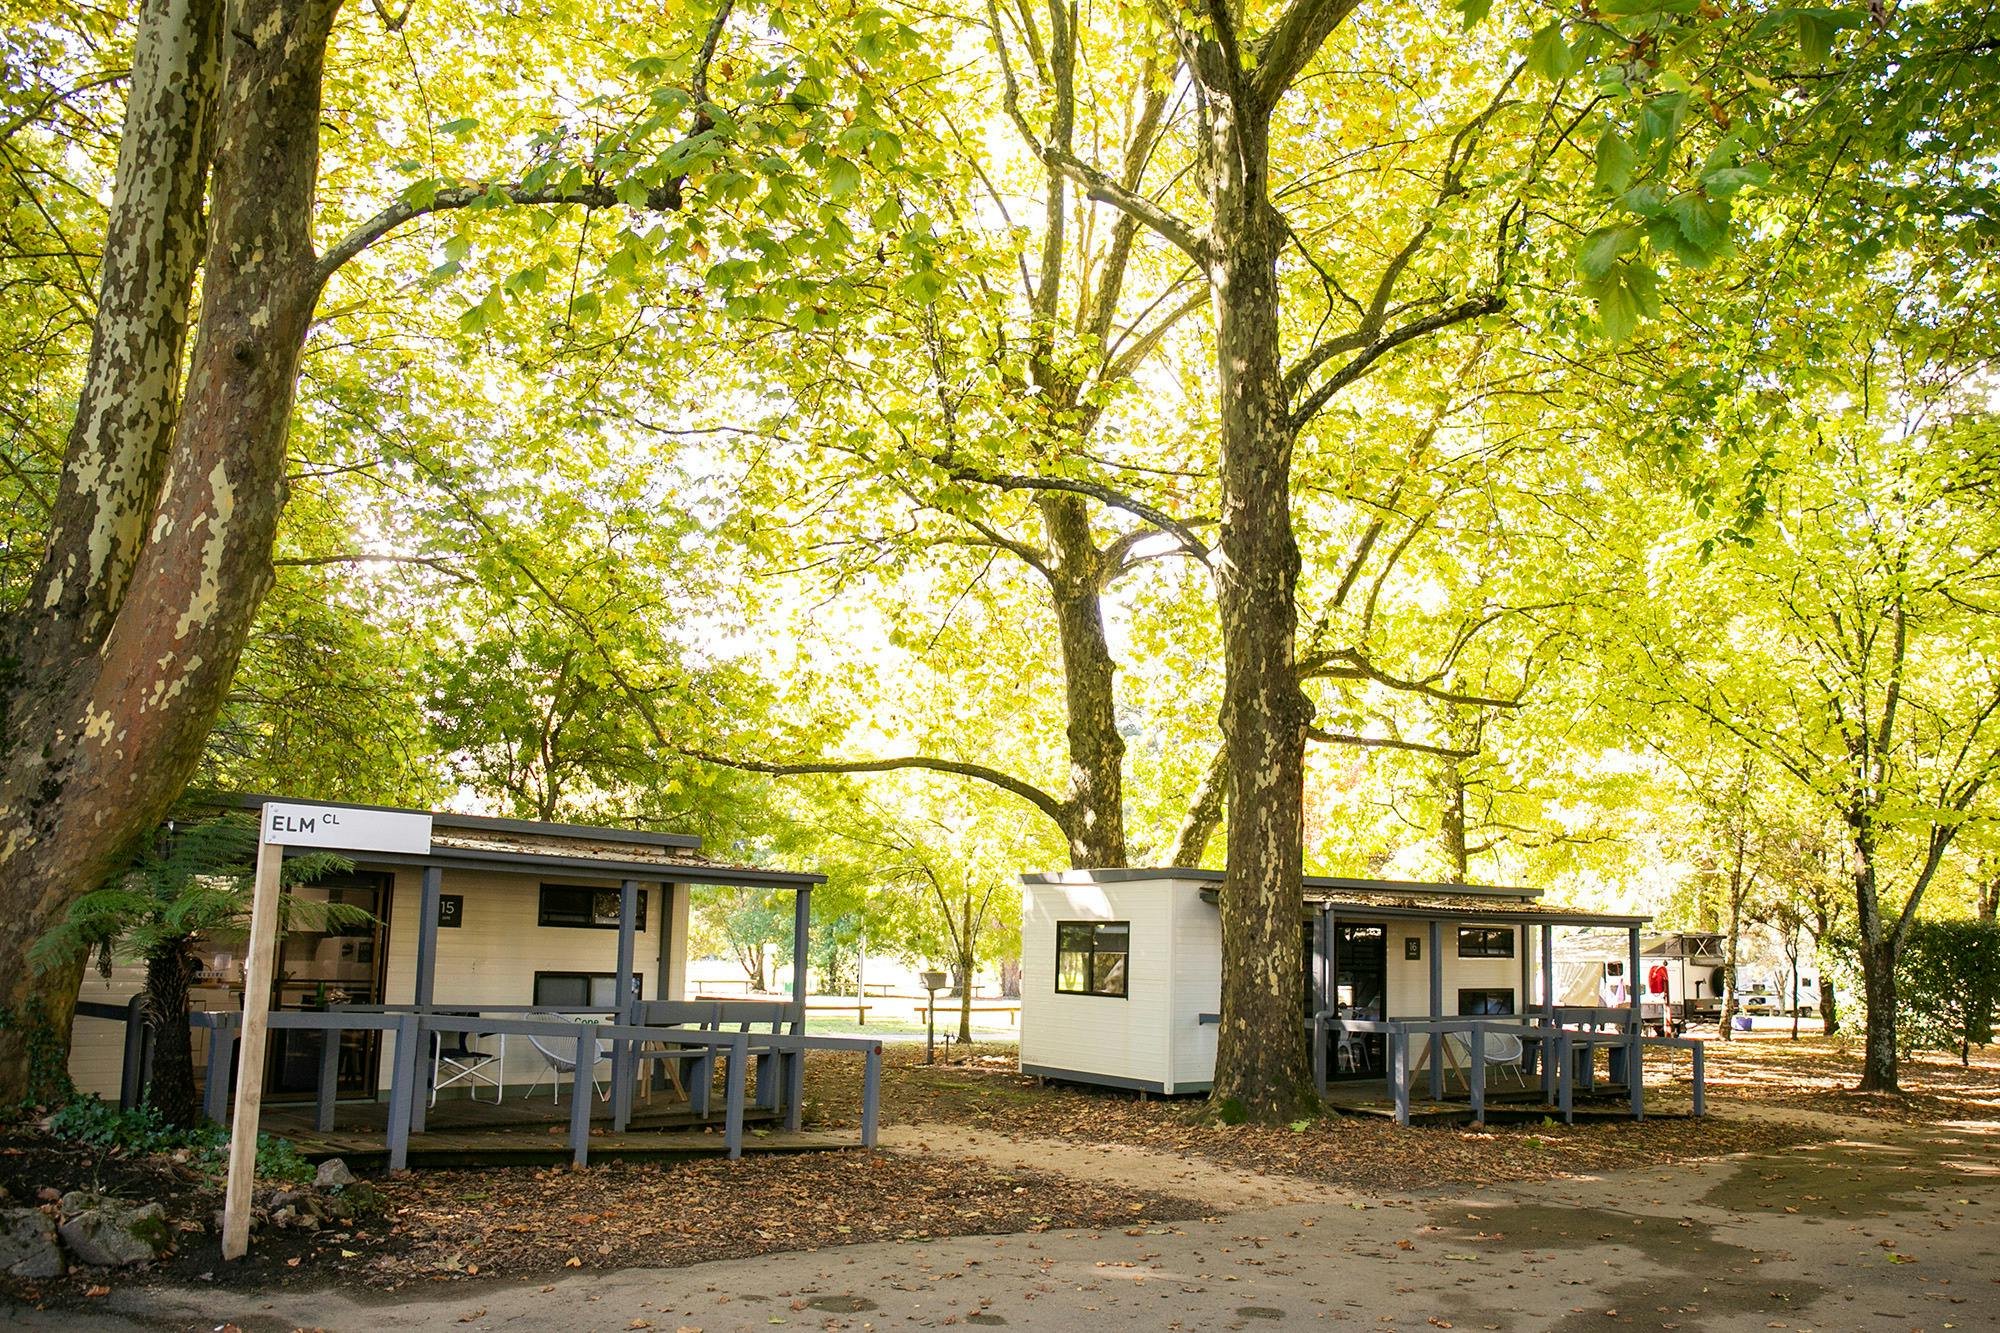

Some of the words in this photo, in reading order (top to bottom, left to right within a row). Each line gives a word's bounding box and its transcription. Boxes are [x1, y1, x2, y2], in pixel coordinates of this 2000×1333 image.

[272, 815, 315, 833] ELM
[322, 813, 340, 825] CL
[441, 901, 455, 914] 15
[1409, 941, 1417, 952] 16
